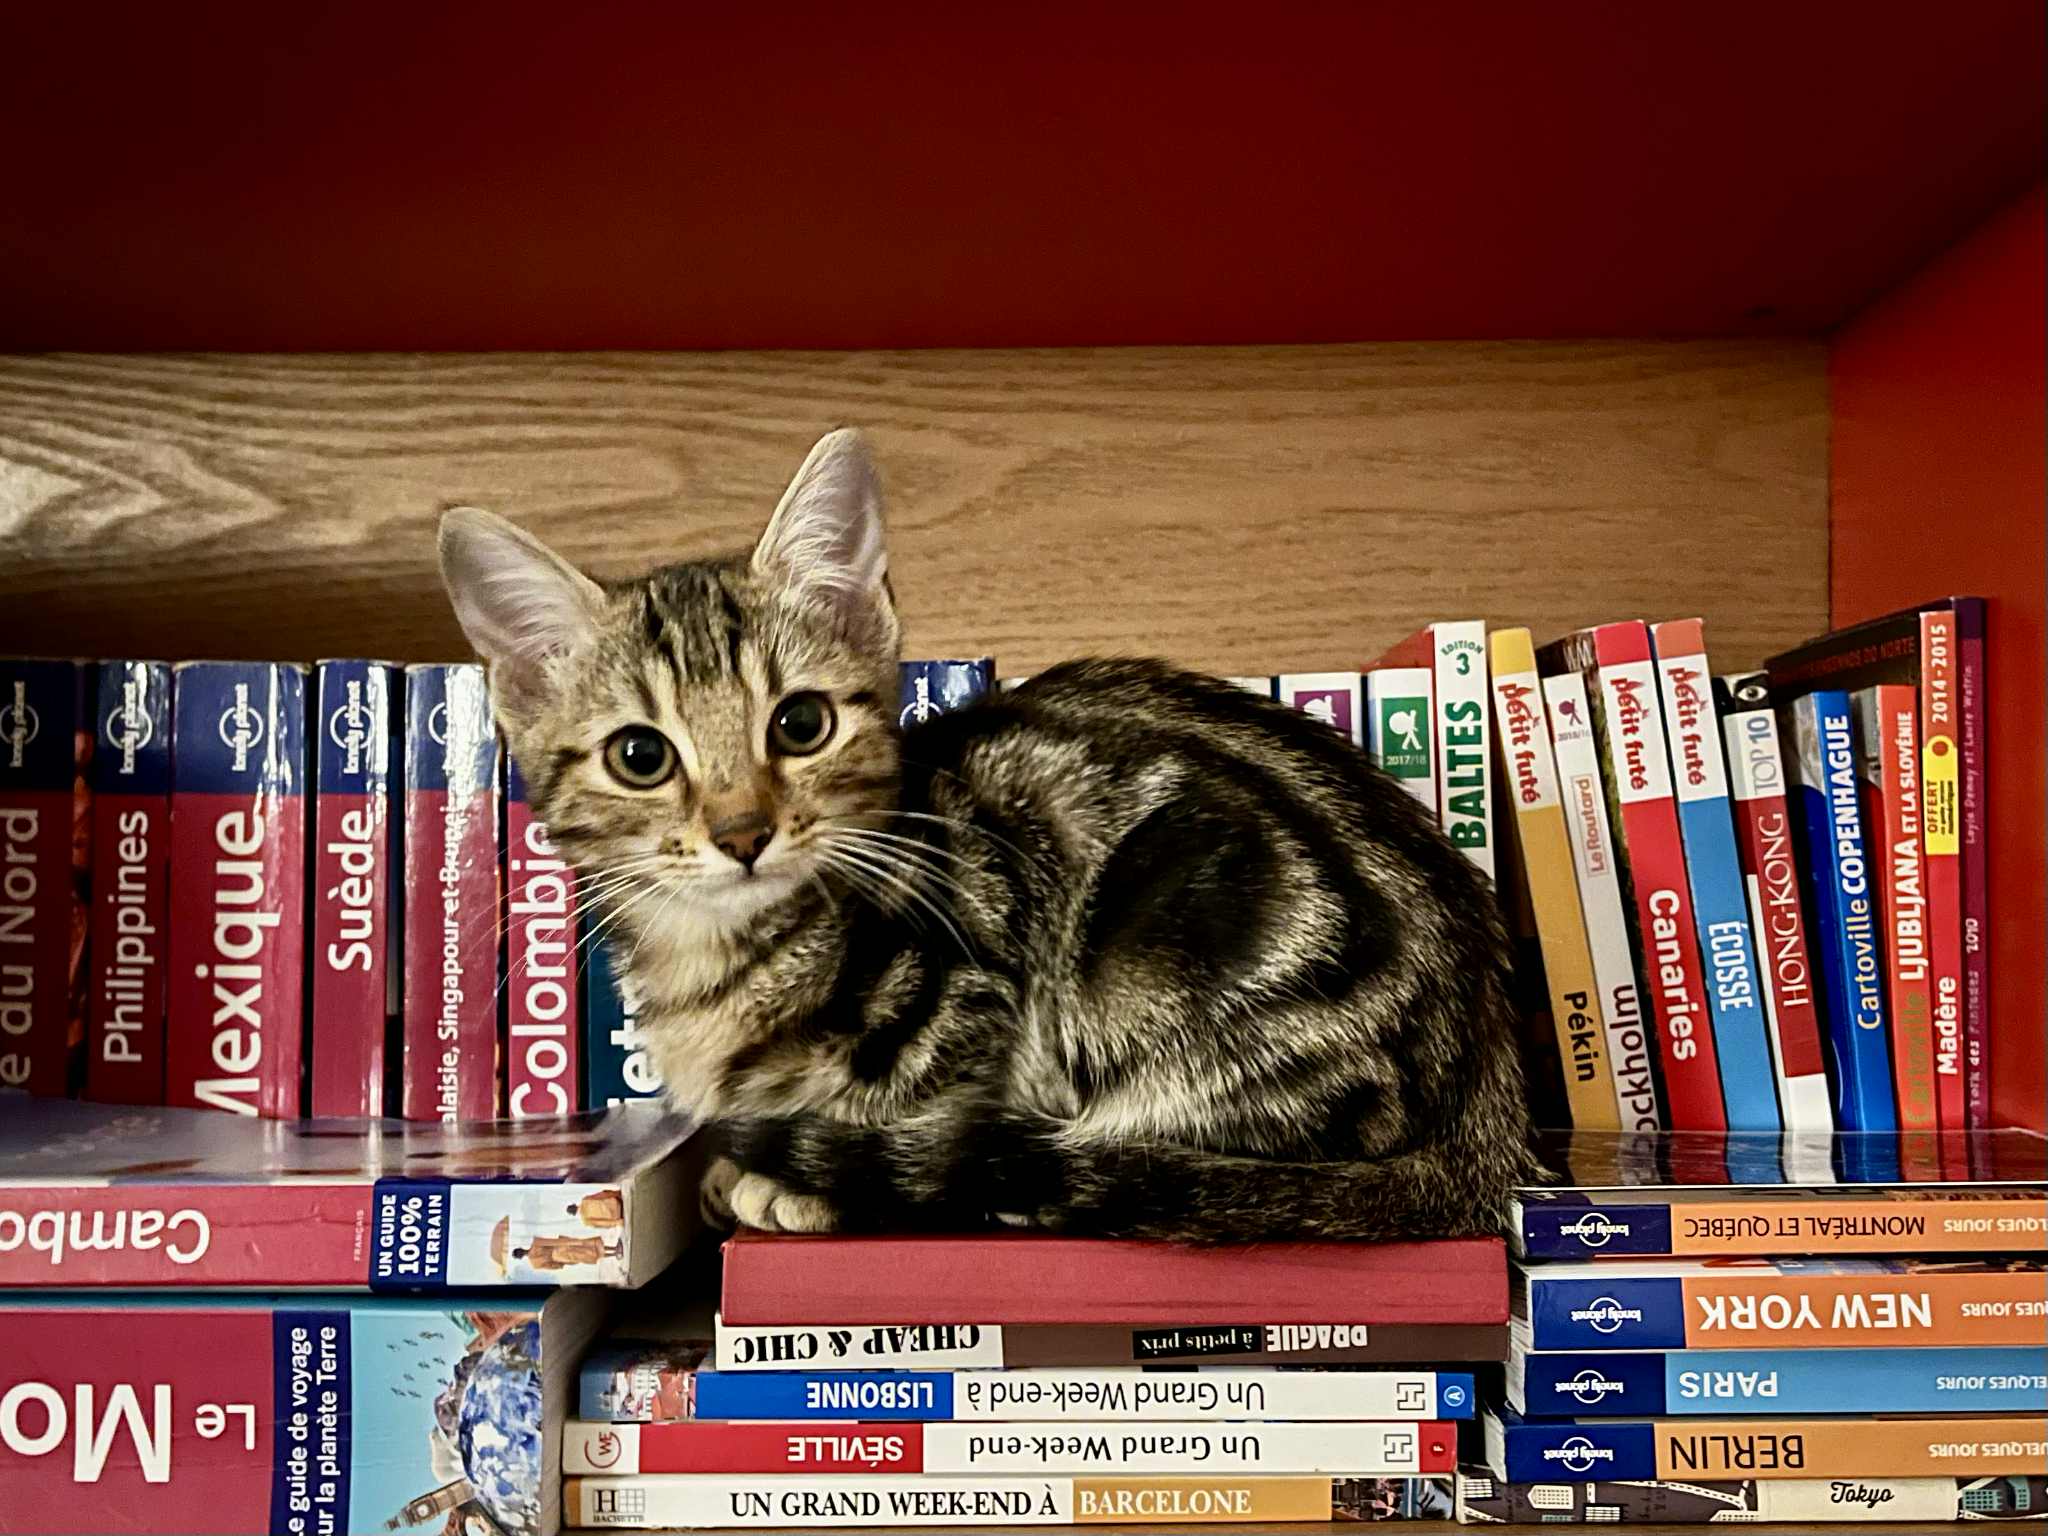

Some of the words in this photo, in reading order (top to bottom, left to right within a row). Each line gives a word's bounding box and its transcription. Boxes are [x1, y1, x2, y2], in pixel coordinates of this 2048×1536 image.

[1441, 639, 1484, 655] EDITION
[1455, 652, 1471, 676] 3
[1930, 623, 1948, 724] 2014-2015
[13, 681, 27, 728] planet
[122, 682, 138, 729] planet
[234, 682, 251, 728] planet
[347, 680, 364, 726] planet
[1746, 715, 1771, 744] 10
[9, 725, 27, 768] lonely
[119, 728, 140, 774] lonely
[232, 727, 252, 772] lonely
[343, 724, 364, 775] lonely
[1386, 754, 1427, 767] 2017/18
[1682, 733, 1706, 786] futé
[1894, 711, 1916, 789] SLOVÉNIE
[1444, 700, 1487, 849] BALTES
[1515, 749, 1541, 805] futé
[1625, 740, 1648, 791] futé
[1750, 750, 1779, 795] TOP
[1576, 777, 1600, 852] Routard
[1825, 714, 1866, 895] COPENHAGUE
[1901, 791, 1917, 812] LA
[1926, 779, 1939, 834] OFFERT
[1901, 814, 1918, 834] ET
[0, 808, 39, 944] Nord
[327, 808, 374, 971] Suède
[441, 886, 460, 909] et
[1757, 813, 1810, 1008] HONG-KONG
[1893, 838, 1929, 980] LJUBLJANA
[103, 810, 155, 1062] Philippines
[1965, 917, 1979, 954] 2010
[1649, 889, 1699, 1061] Canaries
[1708, 920, 1753, 1013] ÉCOSSE
[1845, 898, 1881, 1029] Cartoville
[437, 919, 463, 1041] Singapour
[1564, 990, 1599, 1082] Pékin
[1934, 976, 1958, 1075] Madère
[1902, 991, 1930, 1123] Cartoville
[1967, 1040, 1980, 1067] des
[0, 1208, 211, 1265] Cambo
[354, 1209, 364, 1262] FRANÇAIS
[380, 1194, 397, 1248] GUIDE
[398, 1196, 423, 1275] 100%
[425, 1194, 443, 1277] TERRAIN
[1560, 1223, 1595, 1236] planet
[1596, 1221, 1630, 1237] lonely
[1685, 1215, 1770, 1241] QUÉBEC
[1774, 1217, 1799, 1236] ET
[1805, 1216, 1925, 1240] MONTRÉAL
[1944, 1218, 1994, 1233] JOURS
[378, 1256, 394, 1277] UN
[1571, 1308, 1606, 1321] planet
[1607, 1306, 1642, 1322] lonely
[1696, 1294, 1822, 1331] YORK
[1831, 1293, 1933, 1329] NEW
[1961, 1302, 2013, 1318] JOURS
[316, 1326, 338, 1385] Terre
[733, 1332, 819, 1364] CHIC
[828, 1329, 853, 1358] &
[864, 1325, 981, 1355] CHEAP
[1141, 1332, 1182, 1355] prix
[1186, 1330, 1237, 1352] petits
[1243, 1331, 1254, 1351] à
[291, 1327, 313, 1407] voyage
[806, 1381, 934, 1409] LISBONNE
[967, 1382, 982, 1411] à
[990, 1382, 1128, 1412] Week-end
[1135, 1382, 1218, 1412] Grand
[1226, 1382, 1265, 1412] Un
[1555, 1380, 1590, 1392] planet
[1591, 1379, 1624, 1393] lonely
[1679, 1371, 1778, 1399] PARIS
[1936, 1376, 1986, 1391] JOURS
[0, 1381, 172, 1483] Mo
[194, 1403, 256, 1451] Le
[287, 1412, 308, 1441] de
[316, 1390, 341, 1476] planète
[786, 1436, 904, 1467] SÉVILLE
[969, 1436, 1112, 1463] Week-end
[1122, 1436, 1211, 1462] Grand
[1222, 1436, 1261, 1461] Un
[1544, 1447, 1579, 1460] planet
[1579, 1446, 1613, 1461] lonely
[1670, 1435, 1804, 1469] BERLIN
[1928, 1443, 1977, 1458] JOURS
[286, 1449, 309, 1512] guide
[314, 1480, 336, 1503] la
[1830, 1481, 1895, 1509] Tokyo
[598, 1489, 618, 1513] H
[730, 1491, 772, 1517] UN
[781, 1491, 881, 1518] GRAND
[890, 1491, 1032, 1517] WEEK-END
[1038, 1484, 1059, 1516] À
[1079, 1489, 1253, 1516] BARCELONE
[287, 1517, 305, 1536] e
[317, 1507, 335, 1536] ur
[593, 1514, 645, 1523] HACHETTE
